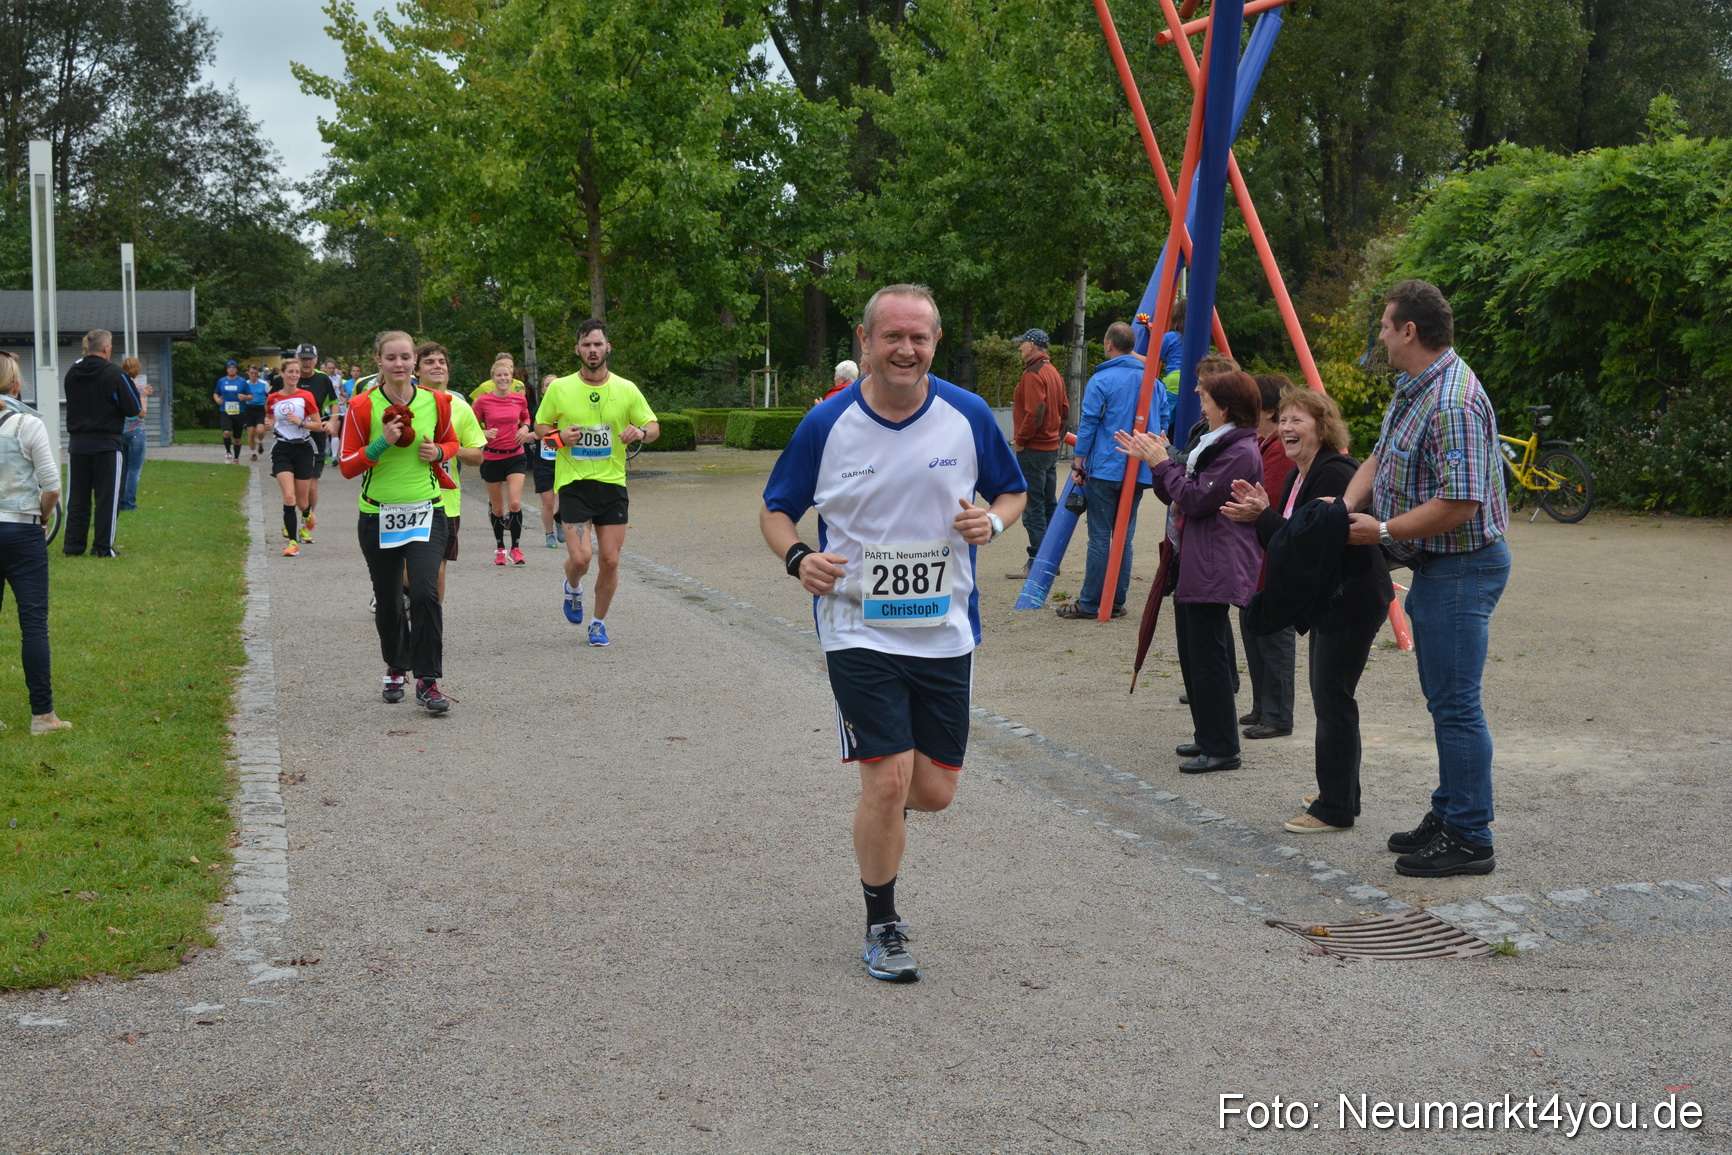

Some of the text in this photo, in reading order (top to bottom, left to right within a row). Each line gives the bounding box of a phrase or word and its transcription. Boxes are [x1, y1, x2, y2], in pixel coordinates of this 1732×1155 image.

[576, 432, 609, 446] 2098
[939, 458, 957, 467] asics
[841, 468, 876, 478] GARMIN
[385, 511, 428, 530] 3347
[864, 549, 940, 560] PARTL Neumarkt
[872, 561, 946, 596] 2887
[881, 602, 939, 617] Christoph
